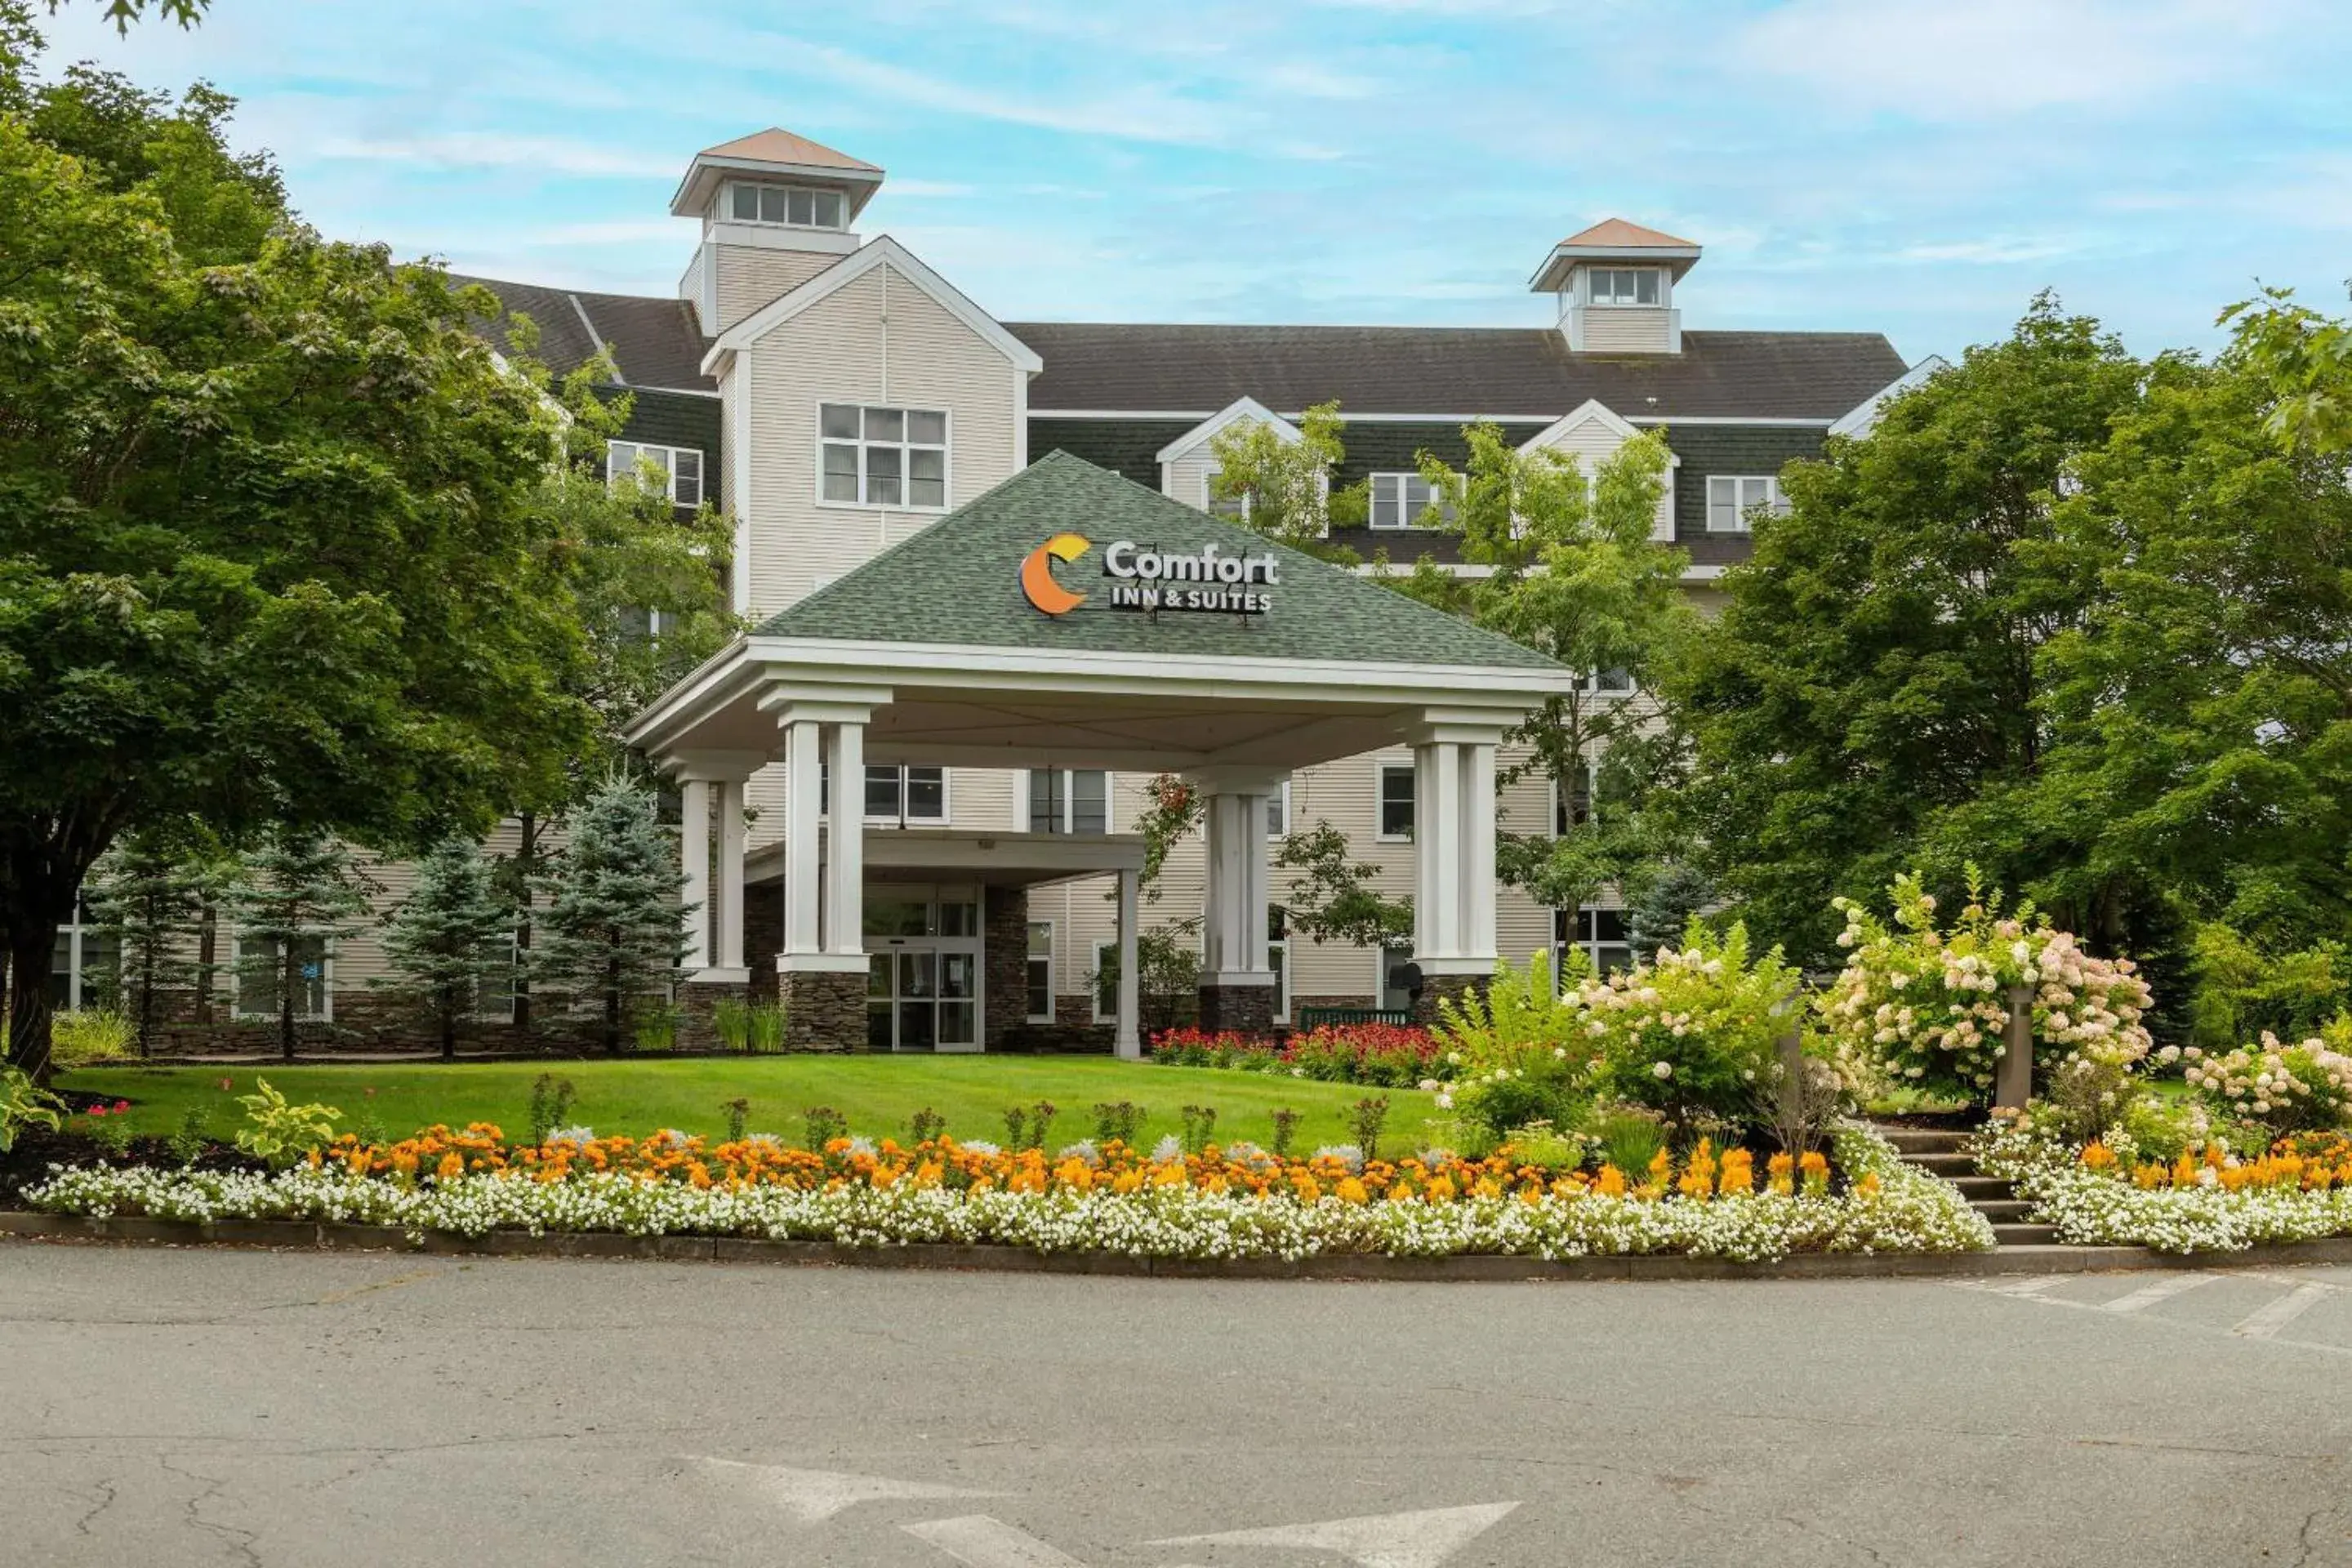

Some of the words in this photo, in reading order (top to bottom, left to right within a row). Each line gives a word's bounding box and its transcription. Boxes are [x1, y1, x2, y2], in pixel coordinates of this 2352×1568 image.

[1106, 540, 1279, 584] Comfort
[1112, 587, 1159, 606] INN
[1165, 590, 1182, 608] &
[1187, 591, 1272, 611] SUITES
